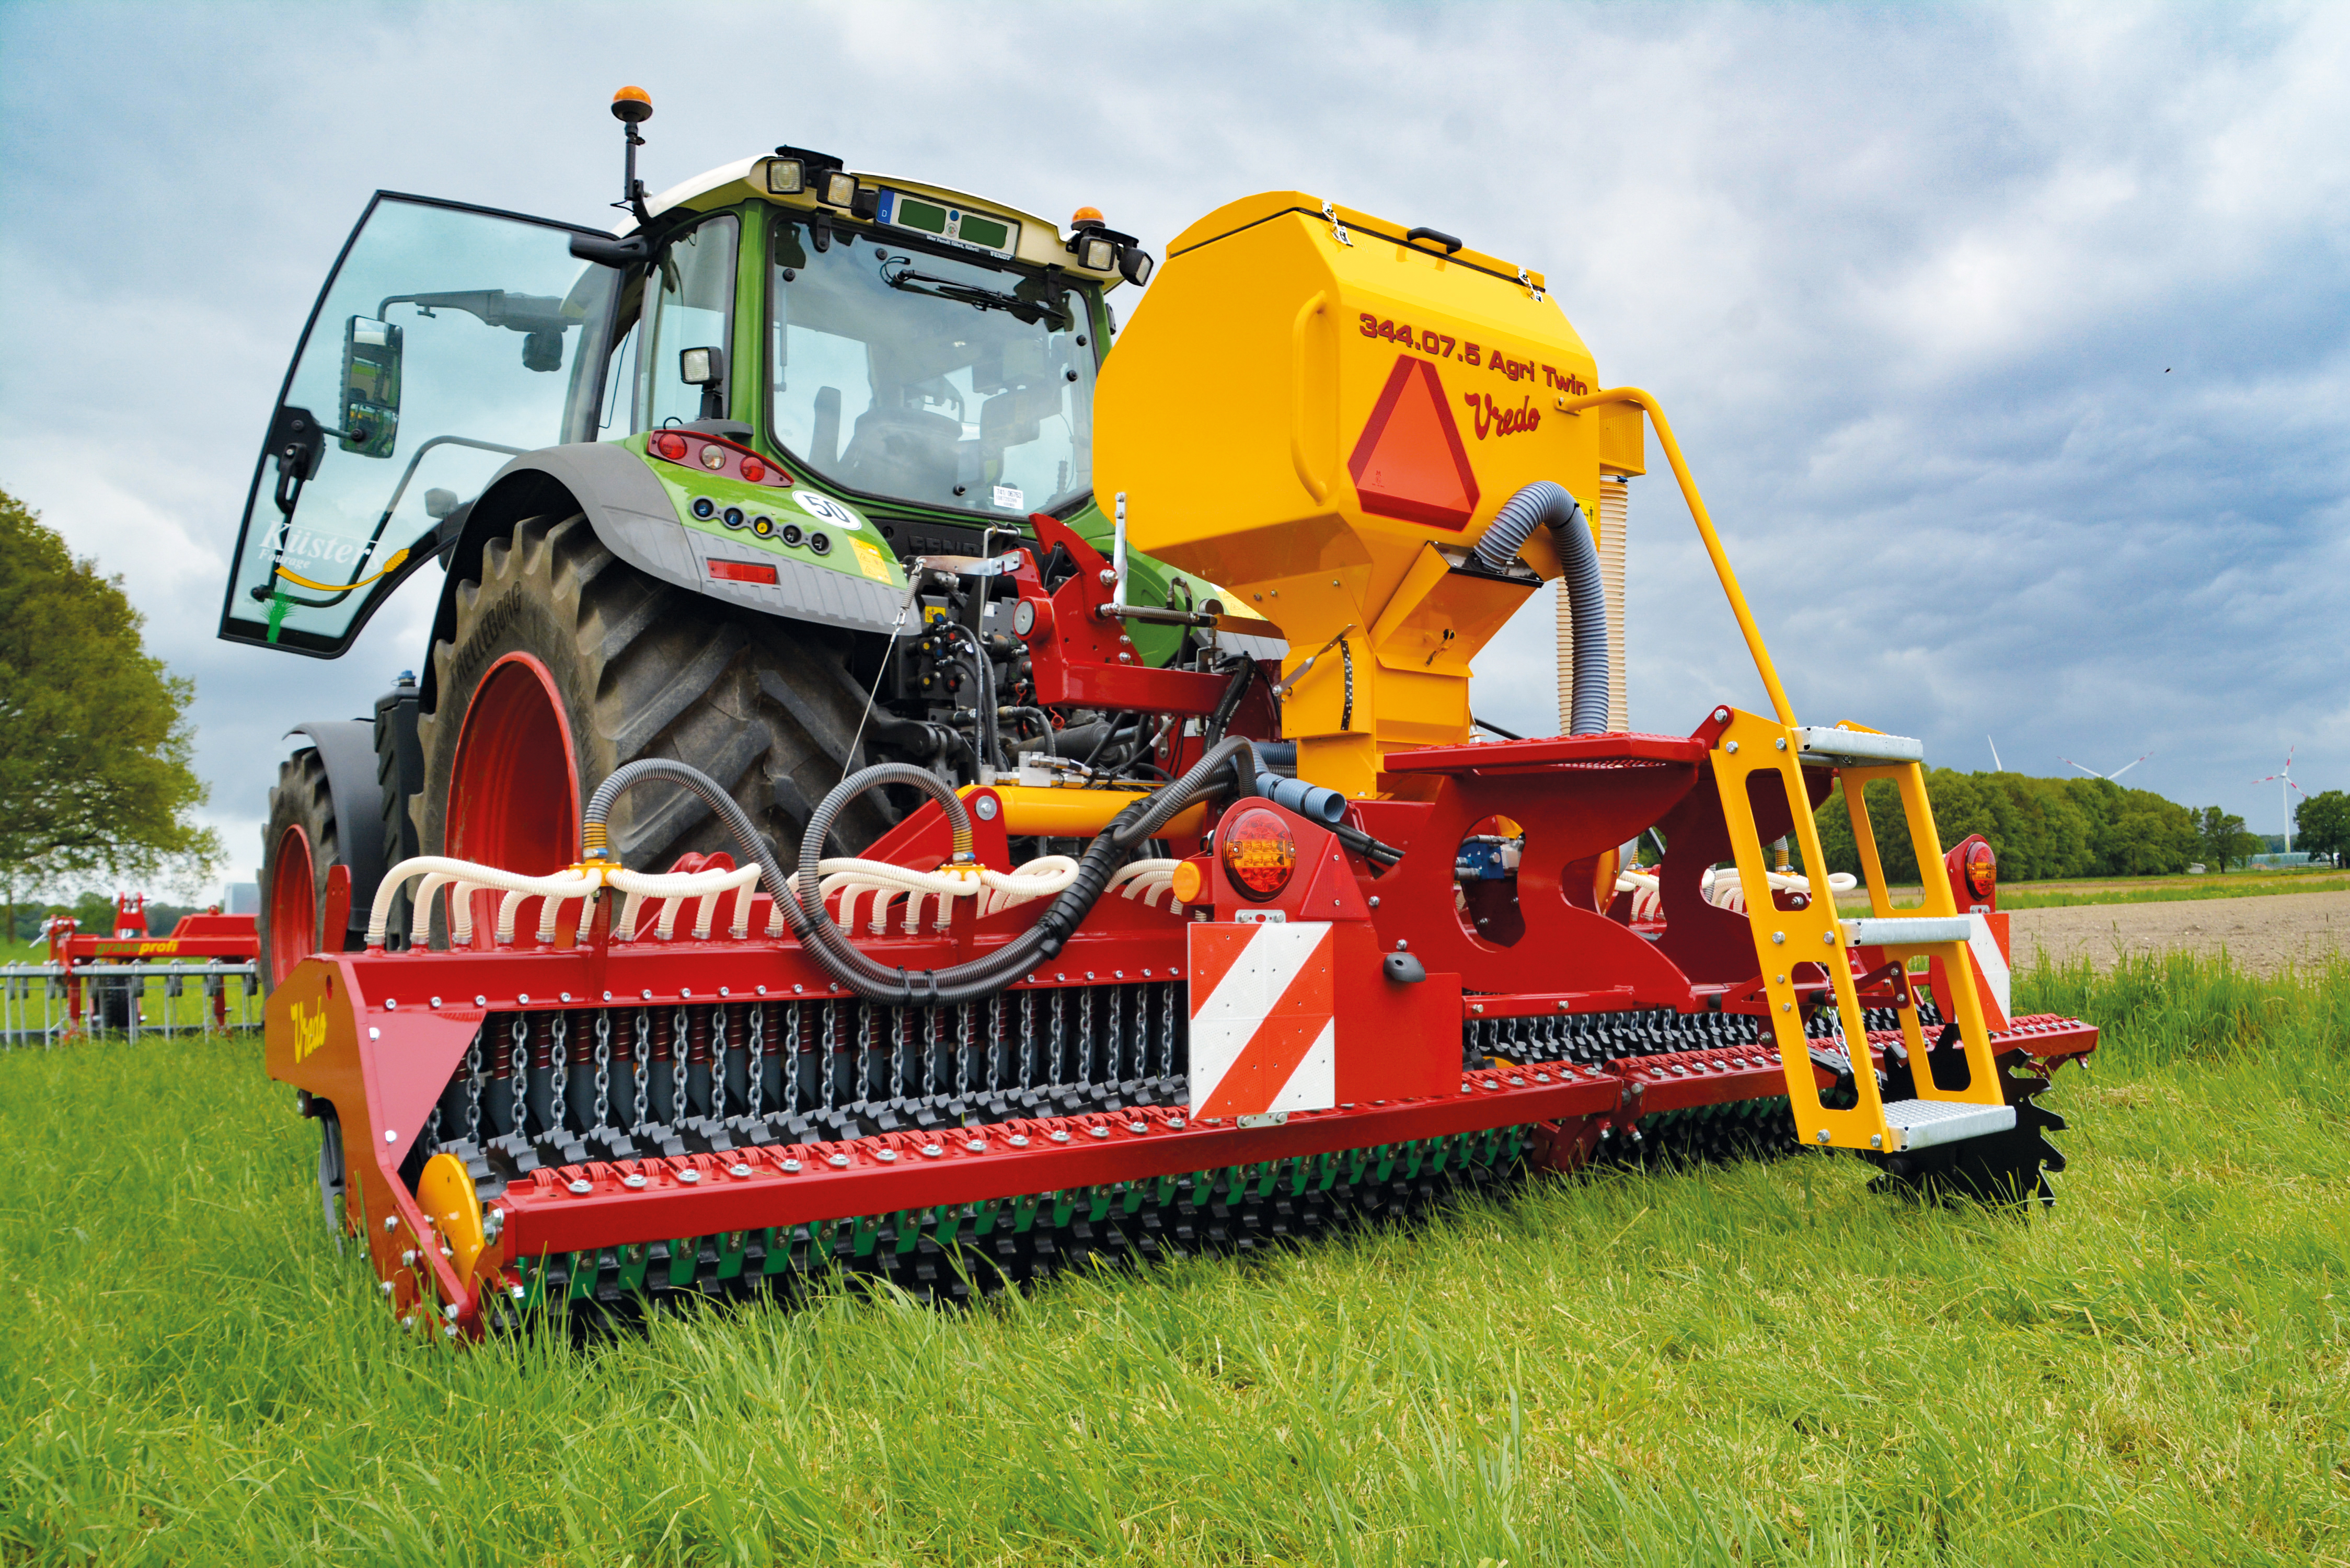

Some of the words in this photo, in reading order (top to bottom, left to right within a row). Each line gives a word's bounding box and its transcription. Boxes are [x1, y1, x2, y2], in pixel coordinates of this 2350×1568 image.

[881, 209, 888, 218] D
[990, 251, 1012, 260] FENDT
[1360, 313, 1481, 366] 344.07.5
[1488, 350, 1535, 382] Agri
[1542, 365, 1588, 396] Twin
[1465, 391, 1541, 441] Vredo
[803, 493, 851, 524] 50
[258, 521, 384, 570] Küsters
[908, 535, 984, 557] FEND
[258, 548, 312, 570] Fourage
[95, 940, 179, 956] grassprofi
[290, 995, 327, 1065] Vredo
